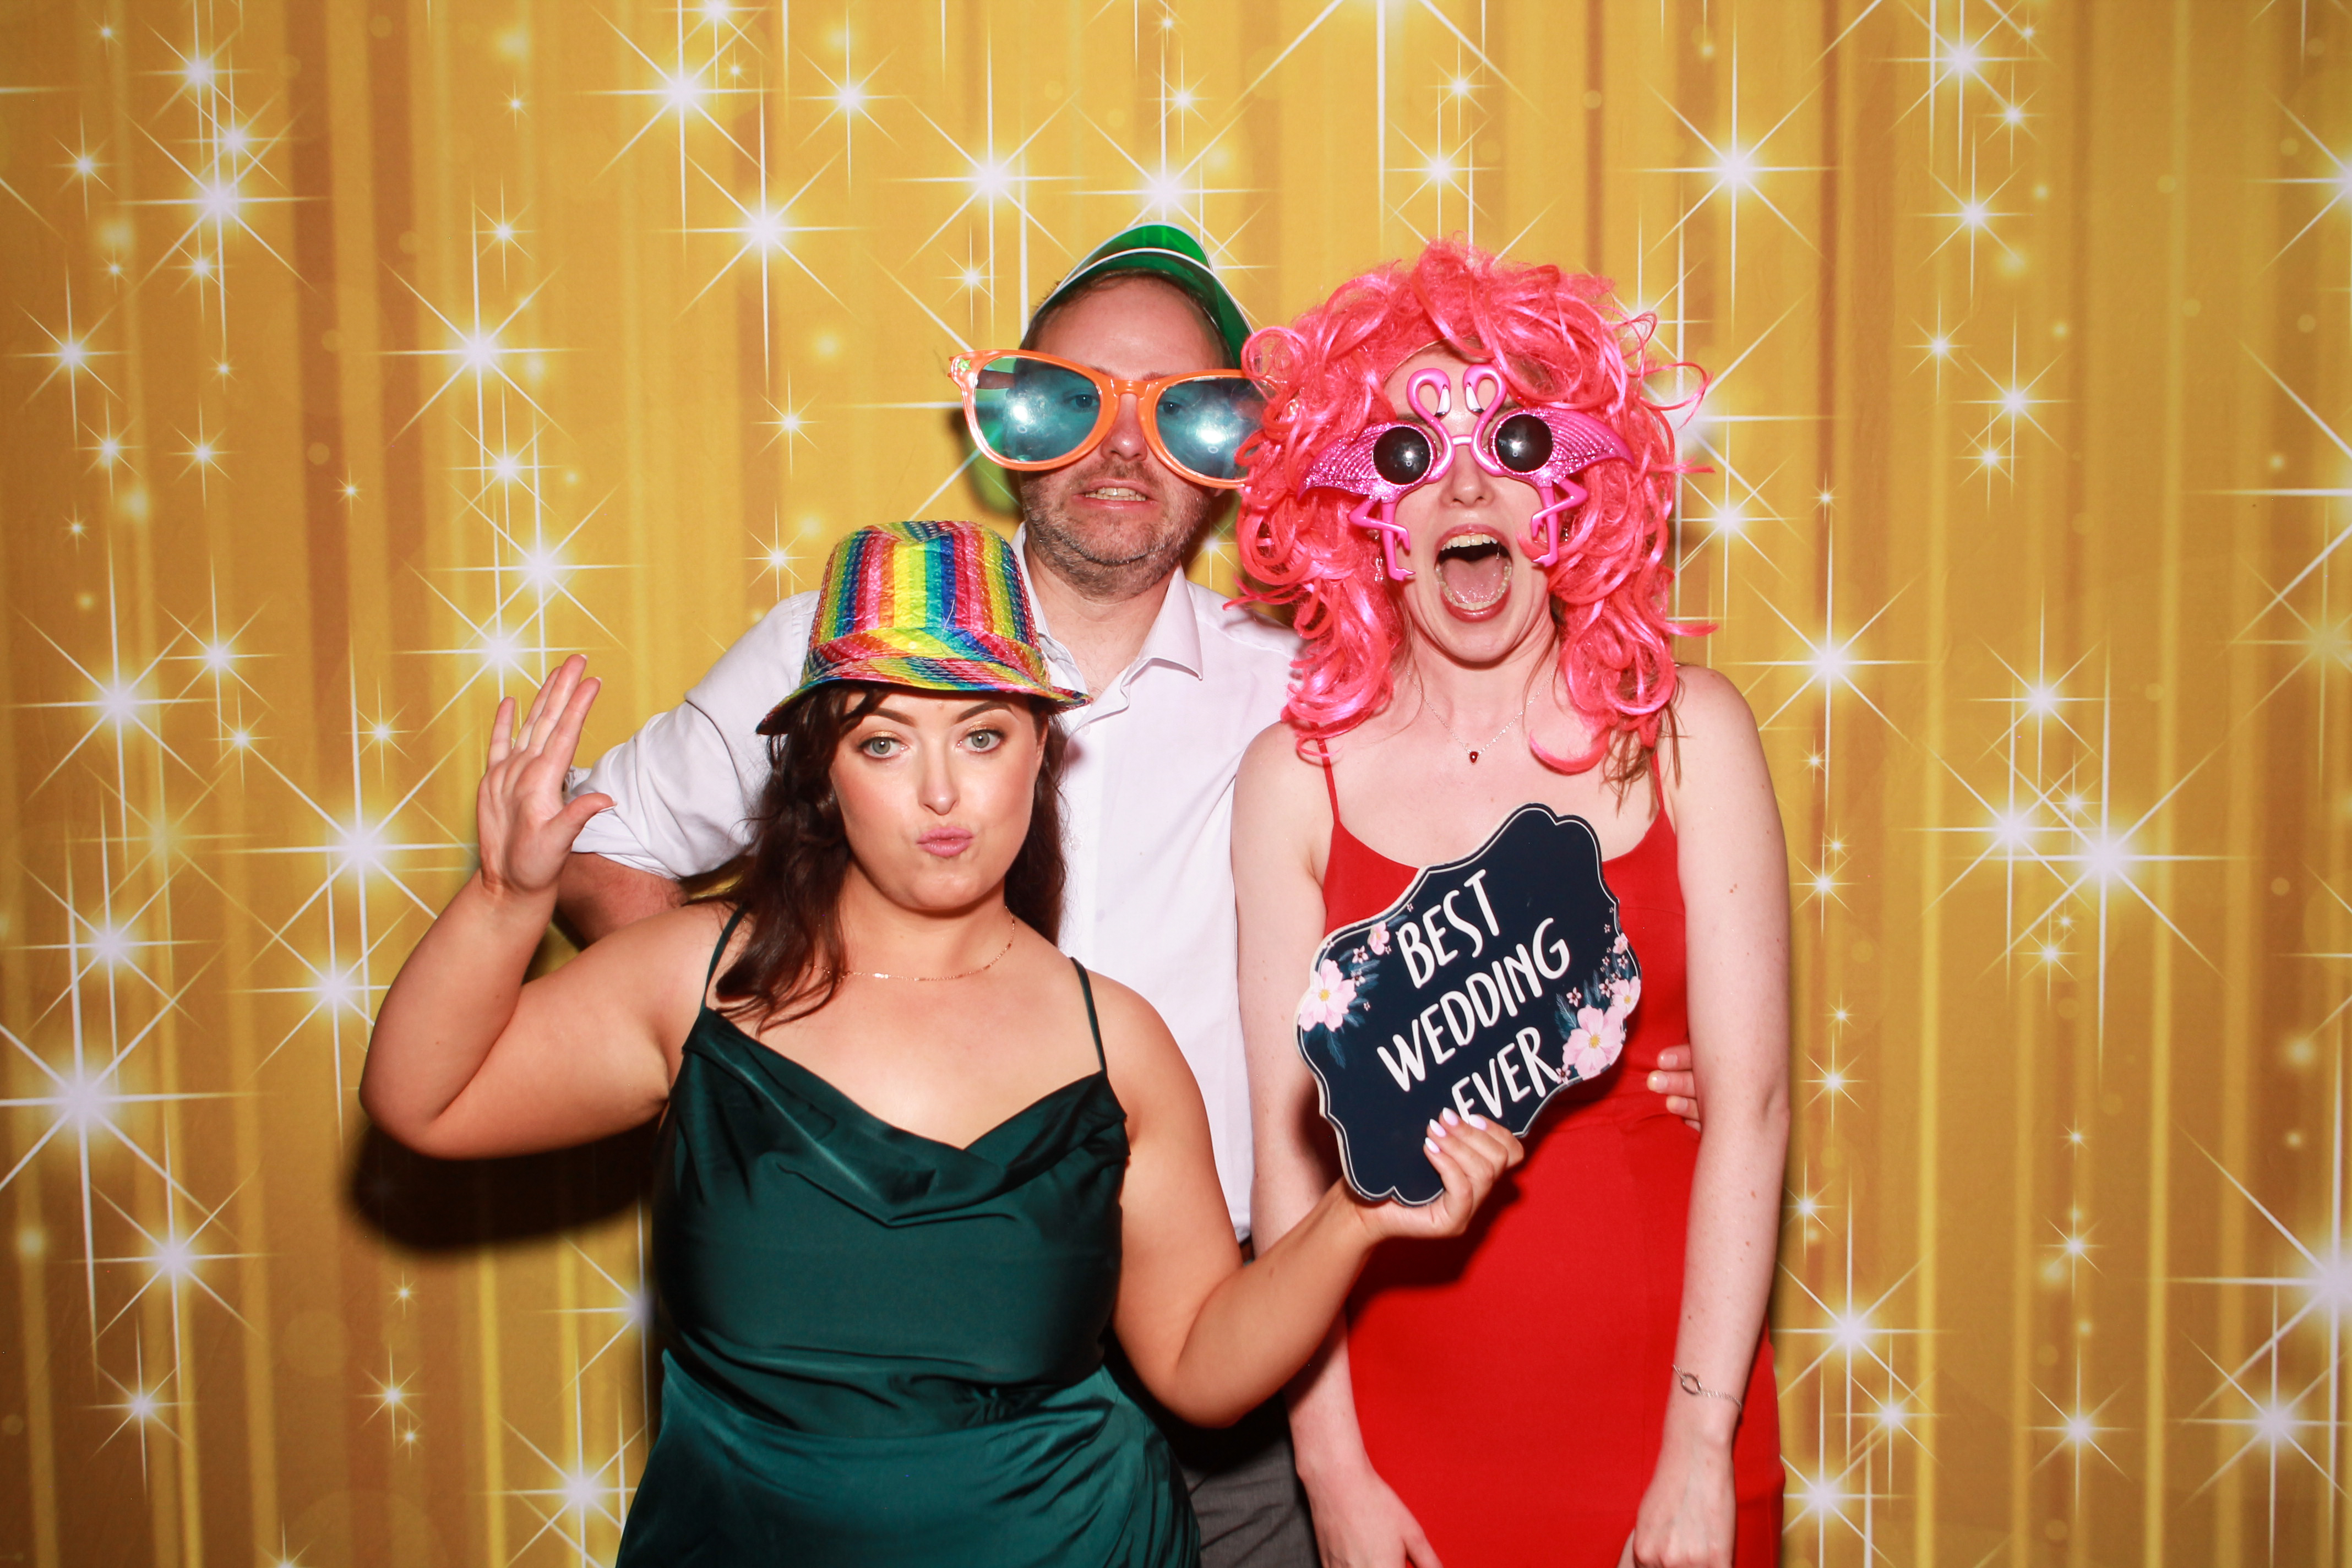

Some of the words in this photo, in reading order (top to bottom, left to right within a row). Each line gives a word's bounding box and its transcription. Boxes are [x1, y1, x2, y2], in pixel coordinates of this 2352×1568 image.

[1396, 868, 1500, 989] BEST
[1376, 917, 1571, 1092] WEDDING
[1451, 1026, 1560, 1124] EVER
